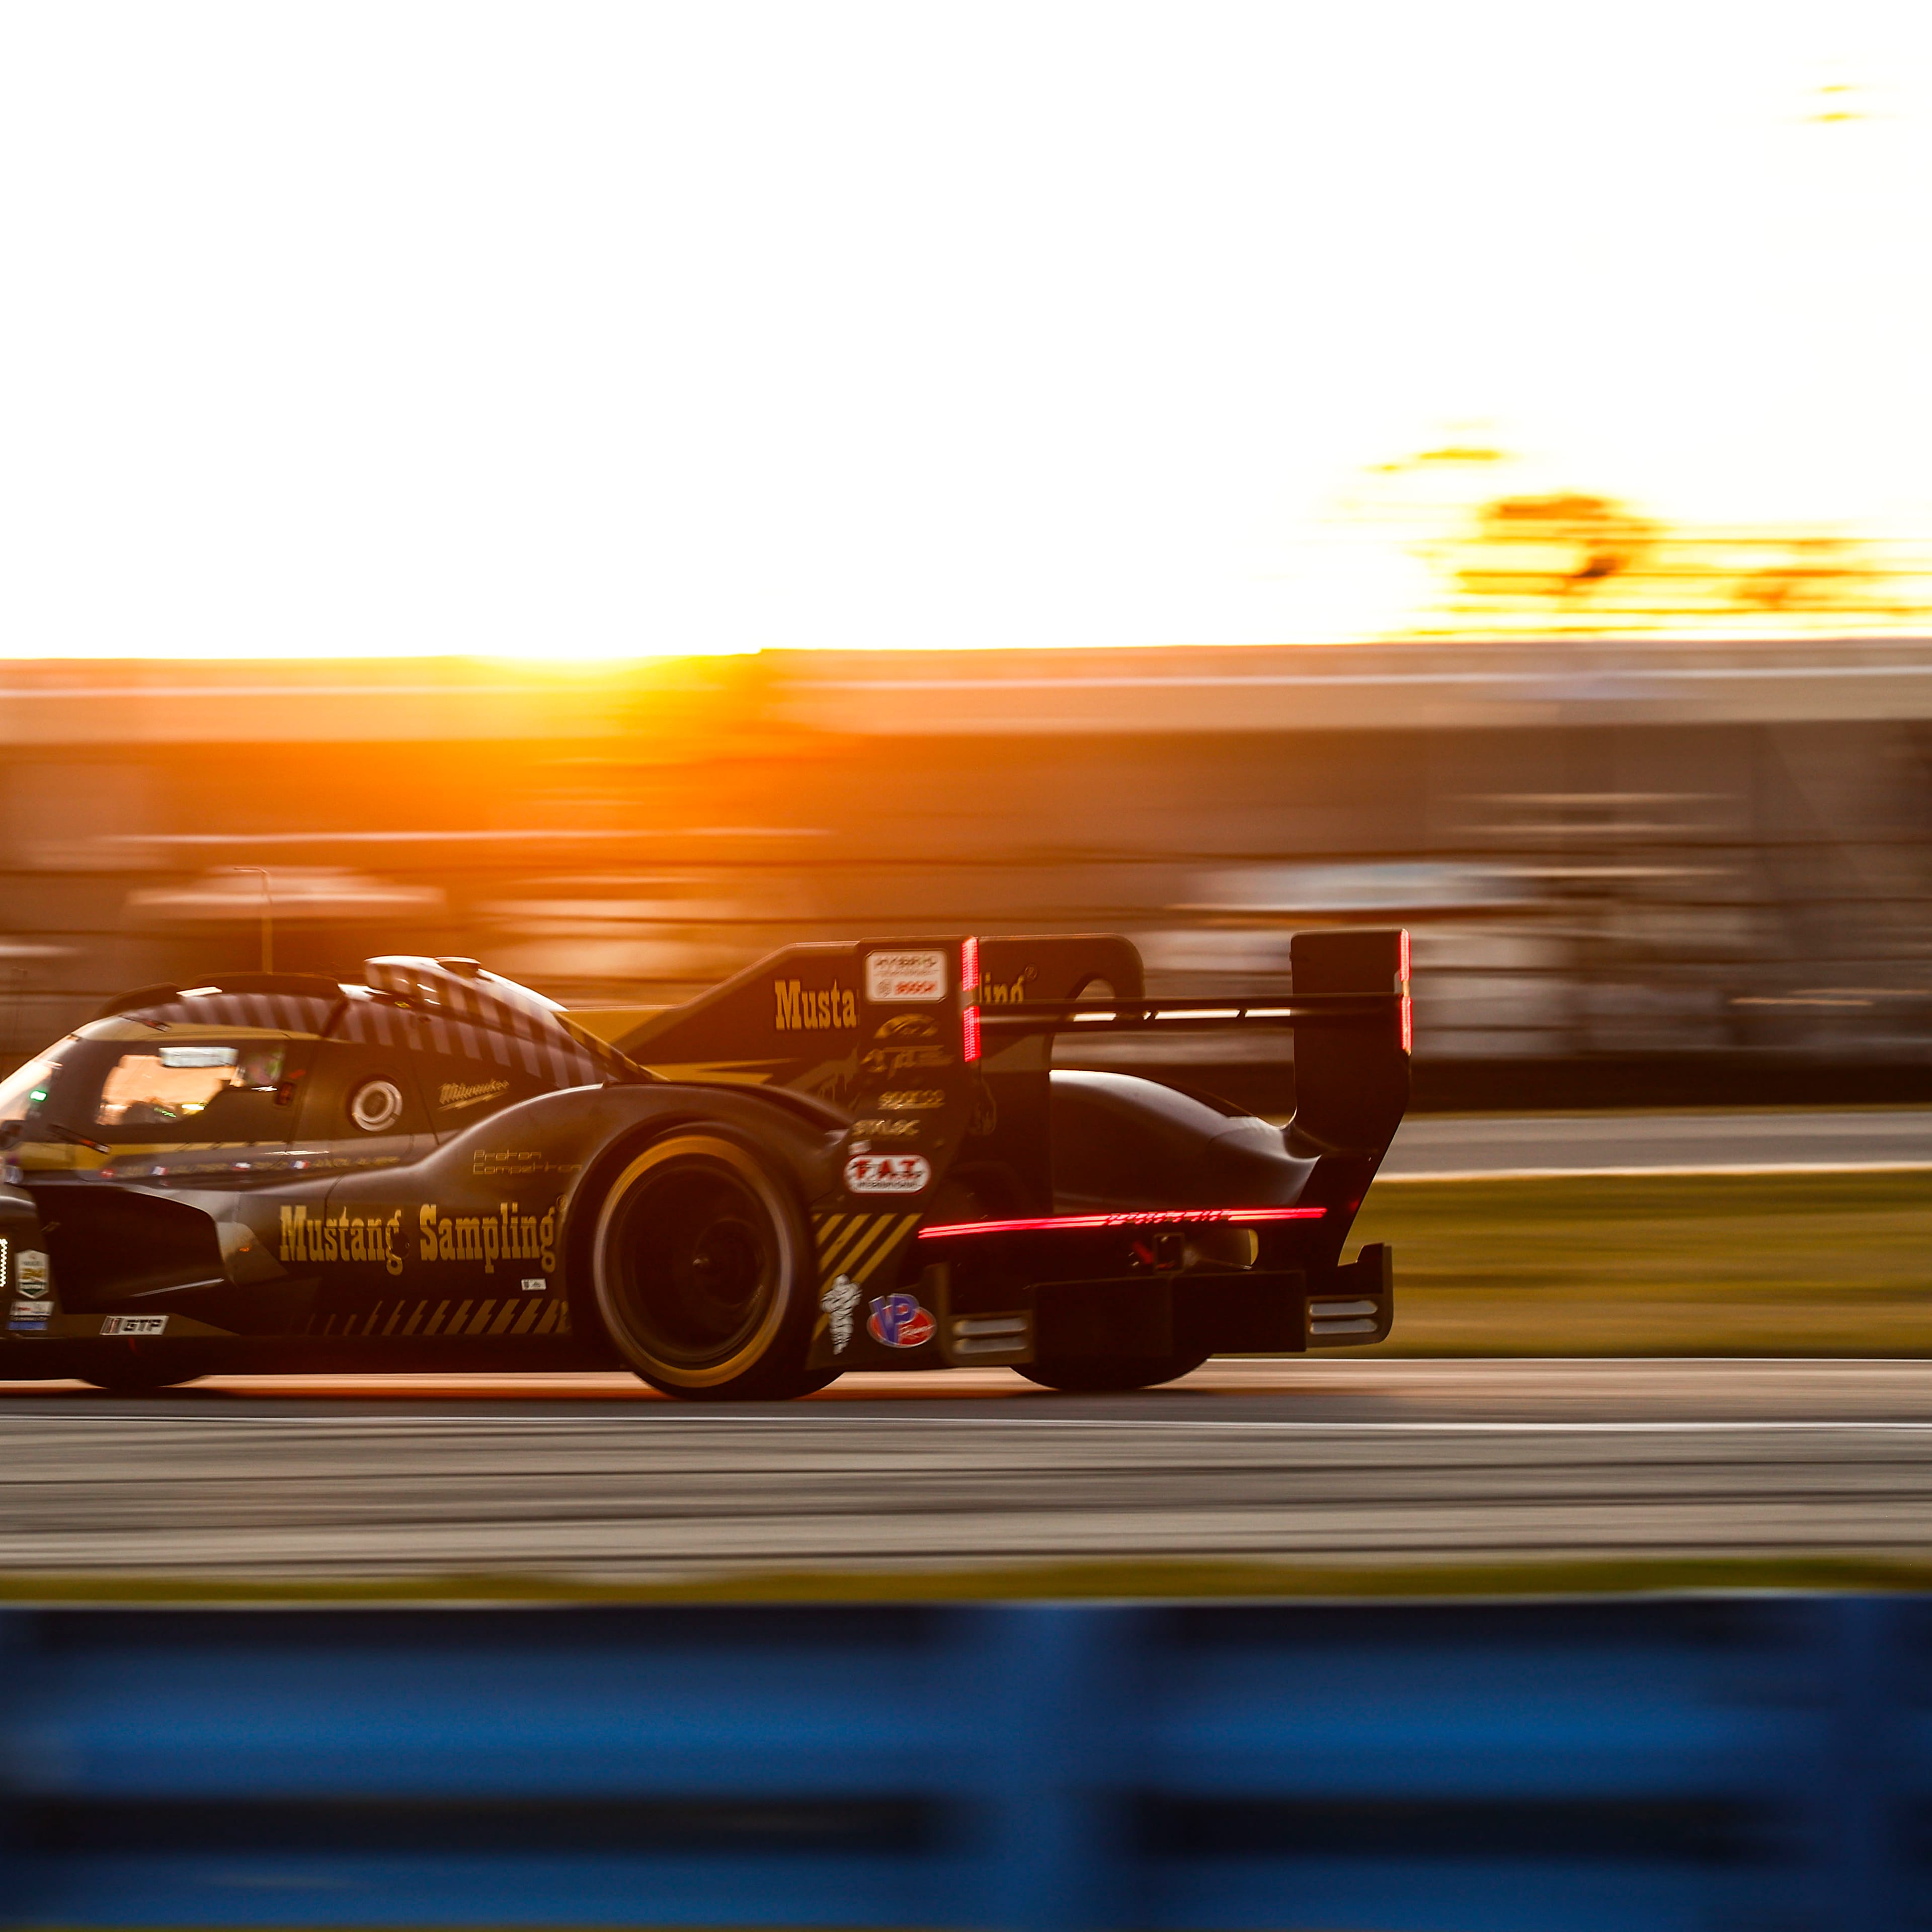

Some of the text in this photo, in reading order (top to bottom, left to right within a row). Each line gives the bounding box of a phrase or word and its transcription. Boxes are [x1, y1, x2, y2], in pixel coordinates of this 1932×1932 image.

[774, 979, 857, 1030] Musta
[438, 1078, 510, 1105] Milwaukee
[280, 1202, 555, 1276] Mustang Sampling
[869, 1293, 920, 1345] VP
